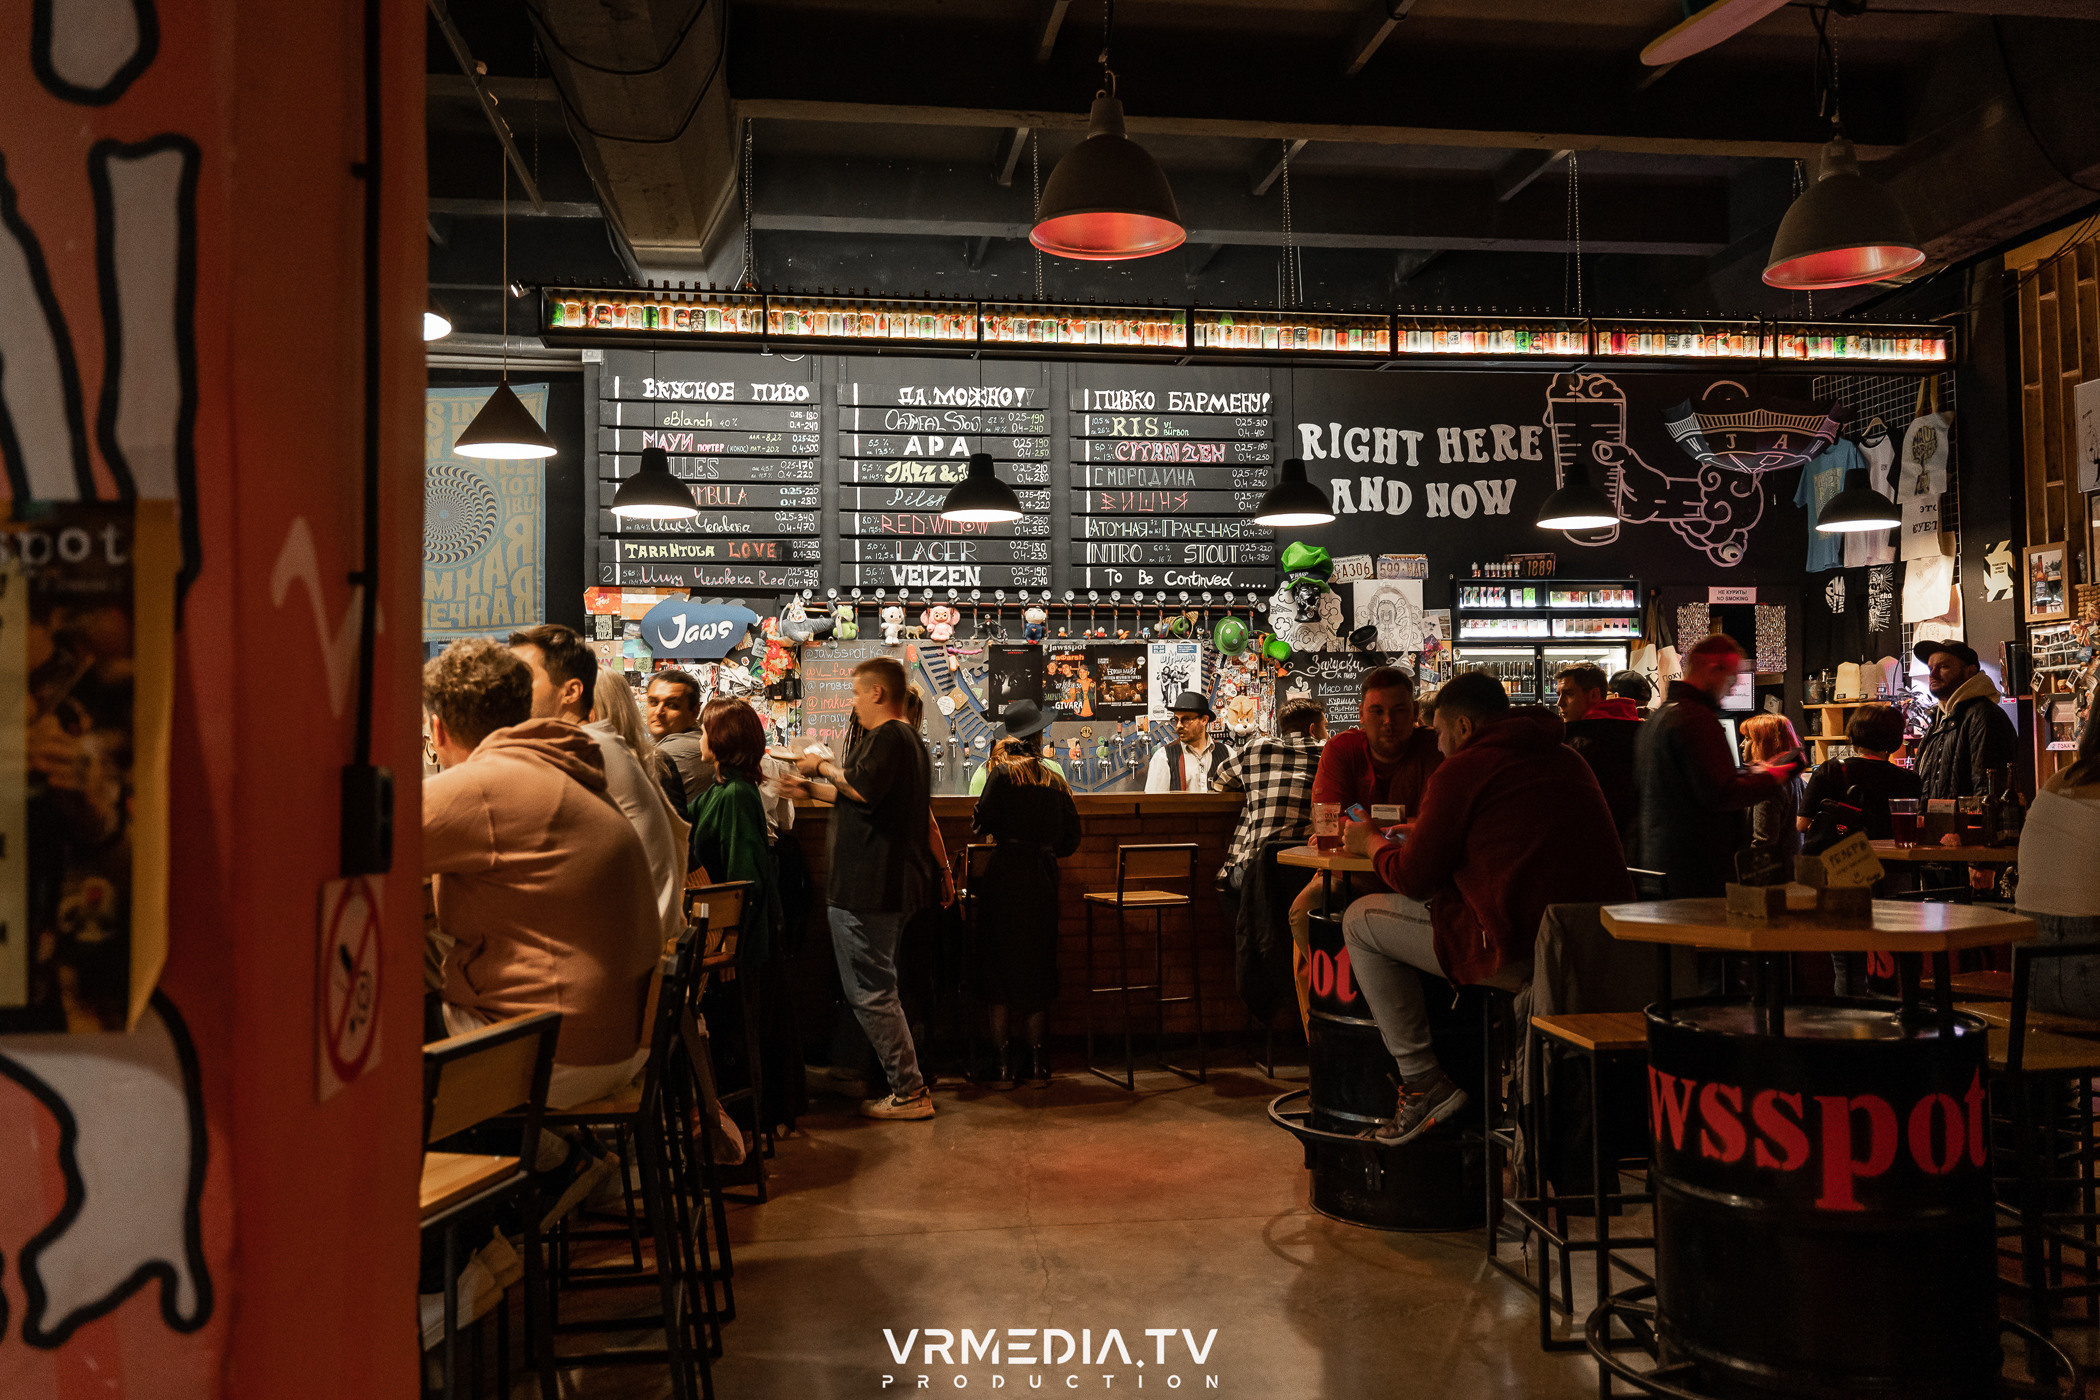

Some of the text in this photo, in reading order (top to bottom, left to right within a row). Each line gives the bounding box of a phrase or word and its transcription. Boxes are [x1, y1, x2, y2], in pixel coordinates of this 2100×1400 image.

[643, 378, 809, 401] ВКУСНОЕ ПИВО
[1094, 390, 1270, 413] ПИВКО БАРМЕНУ!
[664, 410, 712, 427] eBlanch
[1109, 417, 1159, 437] RIS
[1298, 422, 1543, 467] RIGHT HERE
[667, 457, 719, 479] LLES
[885, 461, 936, 483] JAZZ
[1095, 468, 1196, 487] СМОРОДИНА
[1101, 491, 1188, 512] ВИШНЯ
[1331, 476, 1516, 519] AND NOW
[882, 515, 925, 534] RED
[1090, 519, 1240, 537] АТОМНАЯ ПРАЧЕЧНАЯ
[625, 542, 776, 559] TARANTULA LOVE
[896, 541, 977, 561] LAGER
[1091, 544, 1239, 563] NITRO STOUT
[759, 570, 788, 586] Red
[890, 565, 981, 586] WEIZEN
[1104, 568, 1122, 586] To
[1139, 569, 1154, 585] Be
[1528, 560, 1553, 576] 1889
[424, 566, 534, 628] ЕЧНАЯ
[658, 614, 734, 649] Jaws
[1307, 943, 1357, 1004] ot
